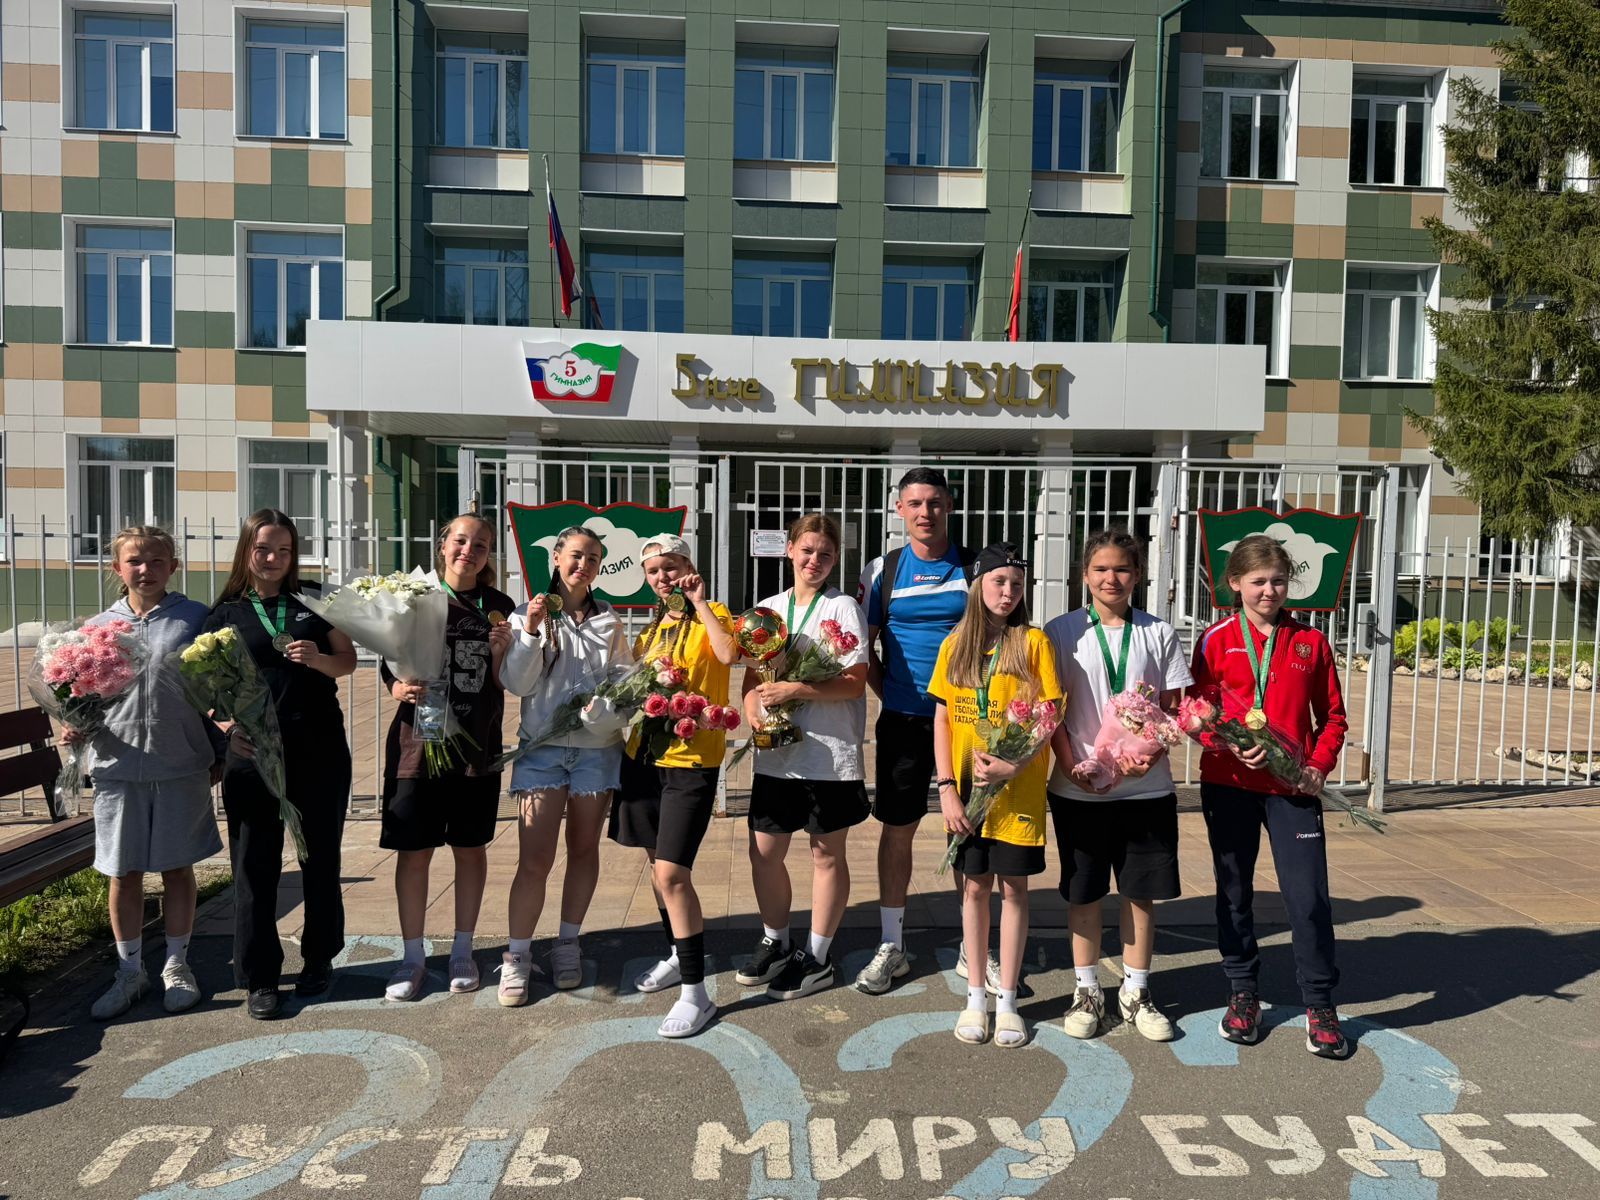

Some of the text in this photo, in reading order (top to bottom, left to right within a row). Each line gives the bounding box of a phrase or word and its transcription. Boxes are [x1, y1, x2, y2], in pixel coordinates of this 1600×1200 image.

[565, 360, 577, 377] 5
[550, 372, 592, 386] ГИМНАЗИЯ
[598, 556, 634, 575] АЗИЯ
[77, 1112, 1600, 1190] ПУСТЬ МИРУ БУДЕТ
